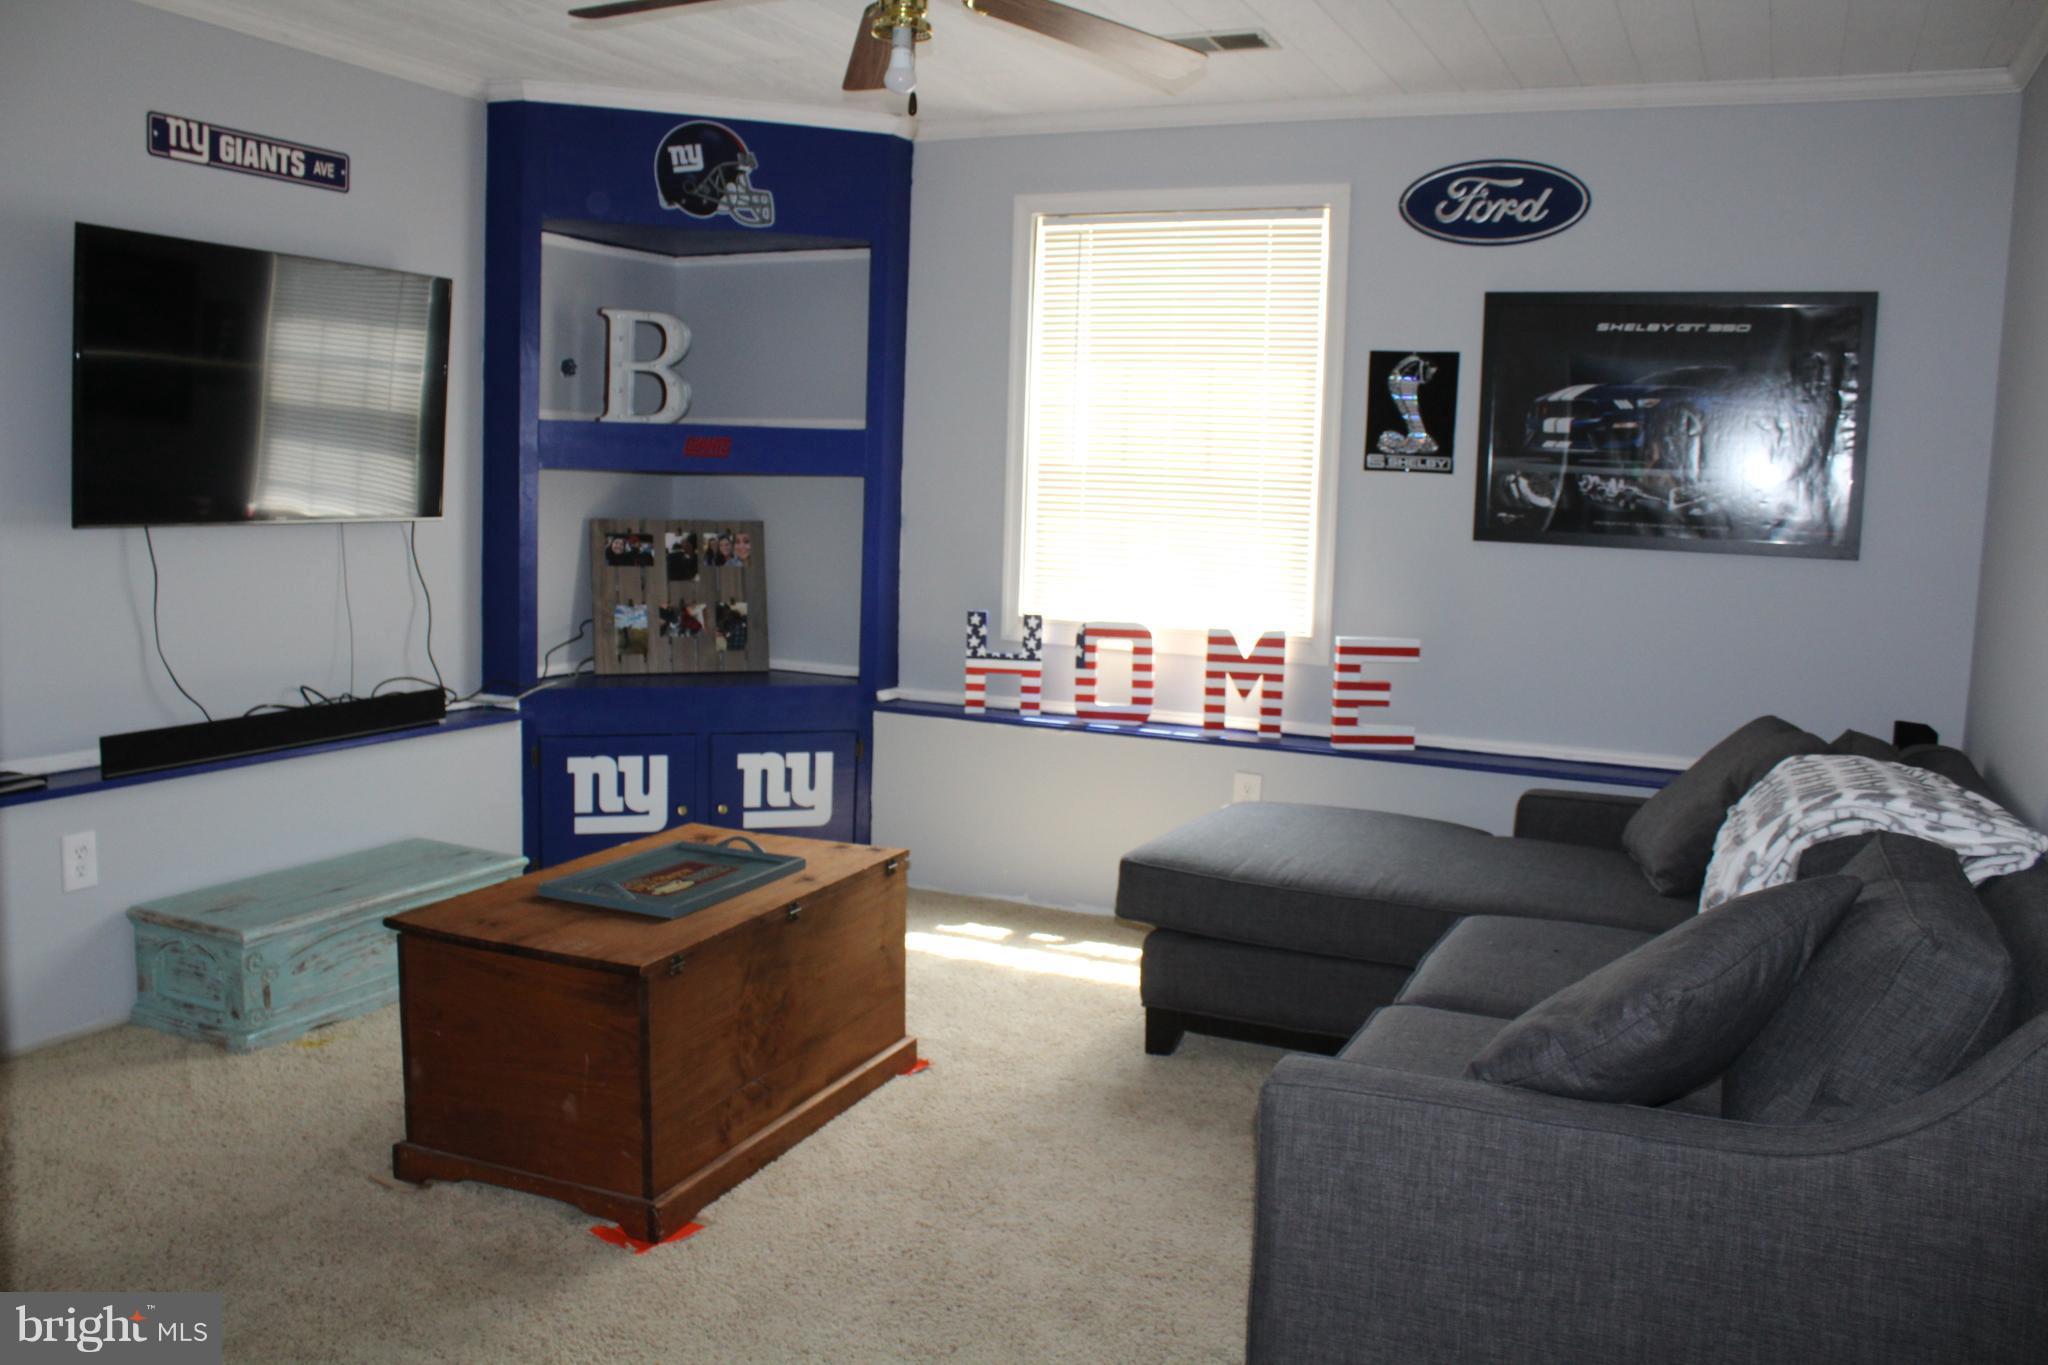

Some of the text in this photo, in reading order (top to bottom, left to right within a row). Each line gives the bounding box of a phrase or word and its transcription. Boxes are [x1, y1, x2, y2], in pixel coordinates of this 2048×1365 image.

[219, 134, 306, 178] GIANTS
[313, 160, 335, 179] AVE
[1435, 176, 1554, 224] Ford
[1596, 322, 1676, 333] SHELBY
[1675, 322, 1706, 333] GT
[596, 307, 693, 424] B
[964, 610, 1421, 751] HOME
